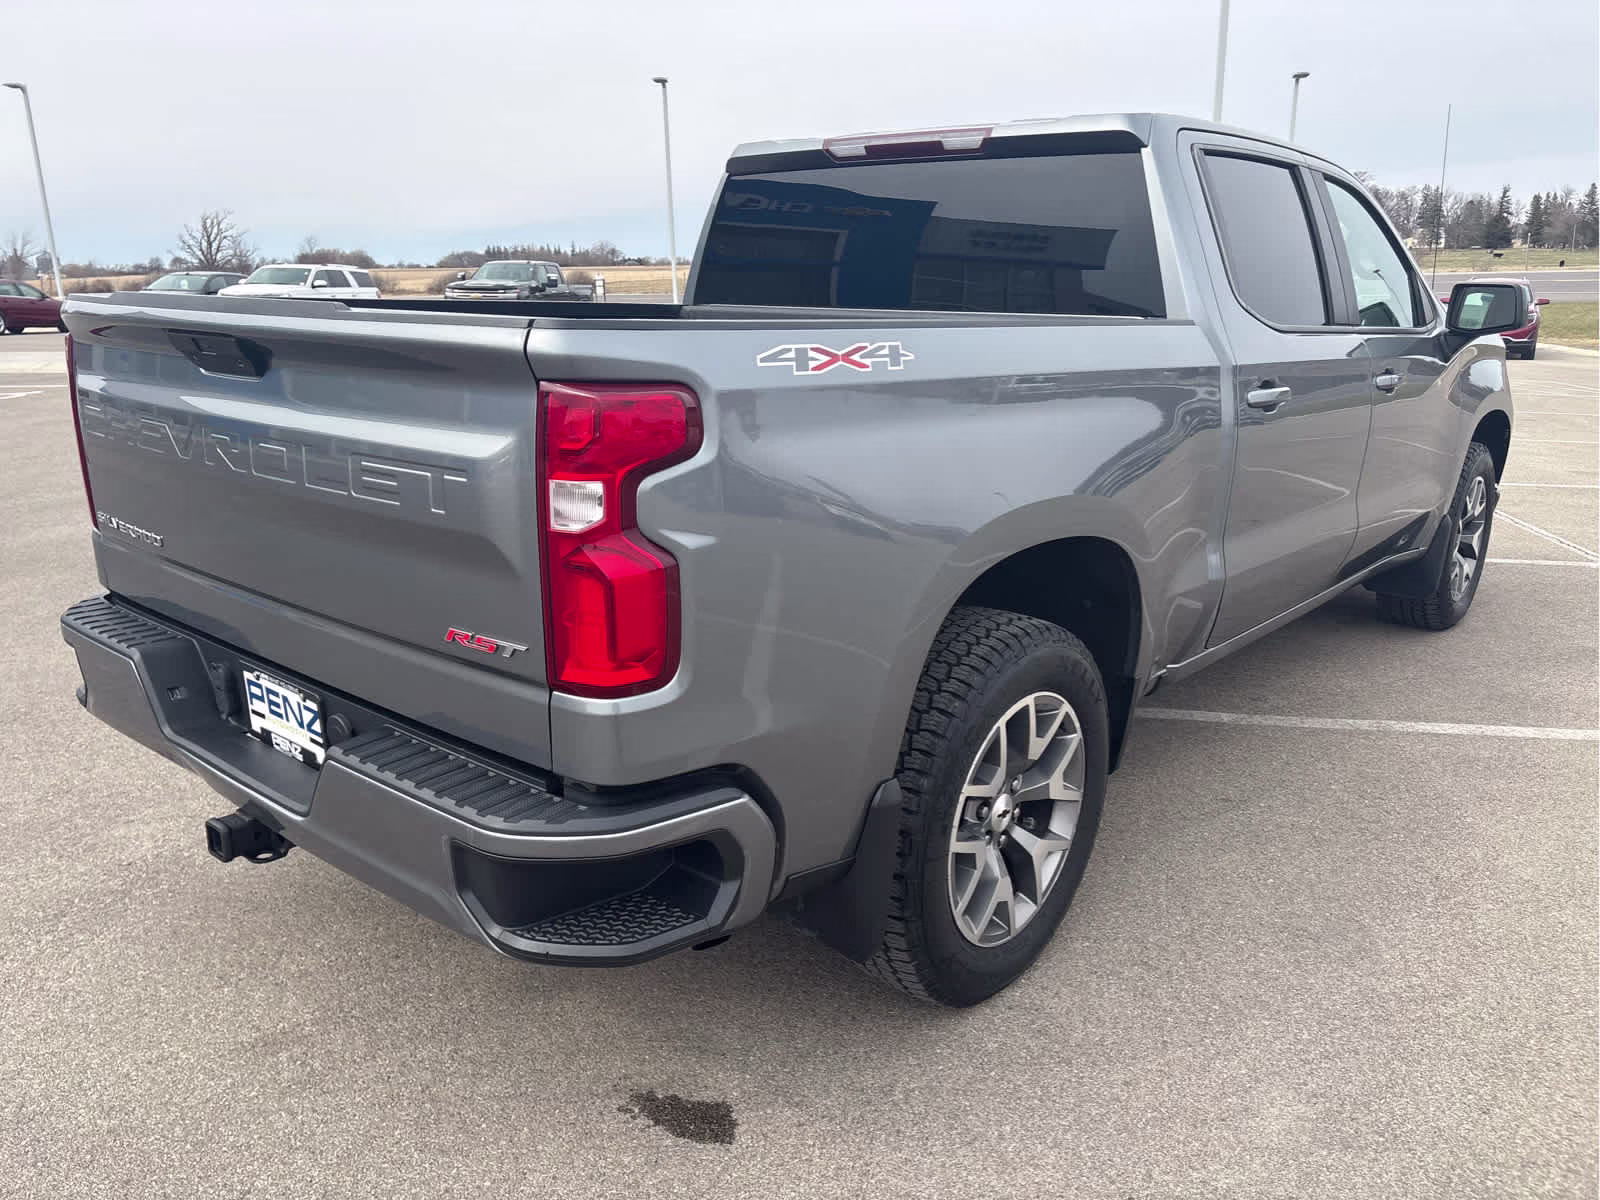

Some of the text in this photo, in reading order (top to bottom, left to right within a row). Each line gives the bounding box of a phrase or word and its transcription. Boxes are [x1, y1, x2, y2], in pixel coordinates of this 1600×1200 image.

[82, 402, 469, 516] CHEVROLET
[97, 511, 164, 547] SILVERADO
[445, 627, 529, 658] RST
[247, 678, 321, 738] PENZ
[271, 732, 303, 756] PENZ
